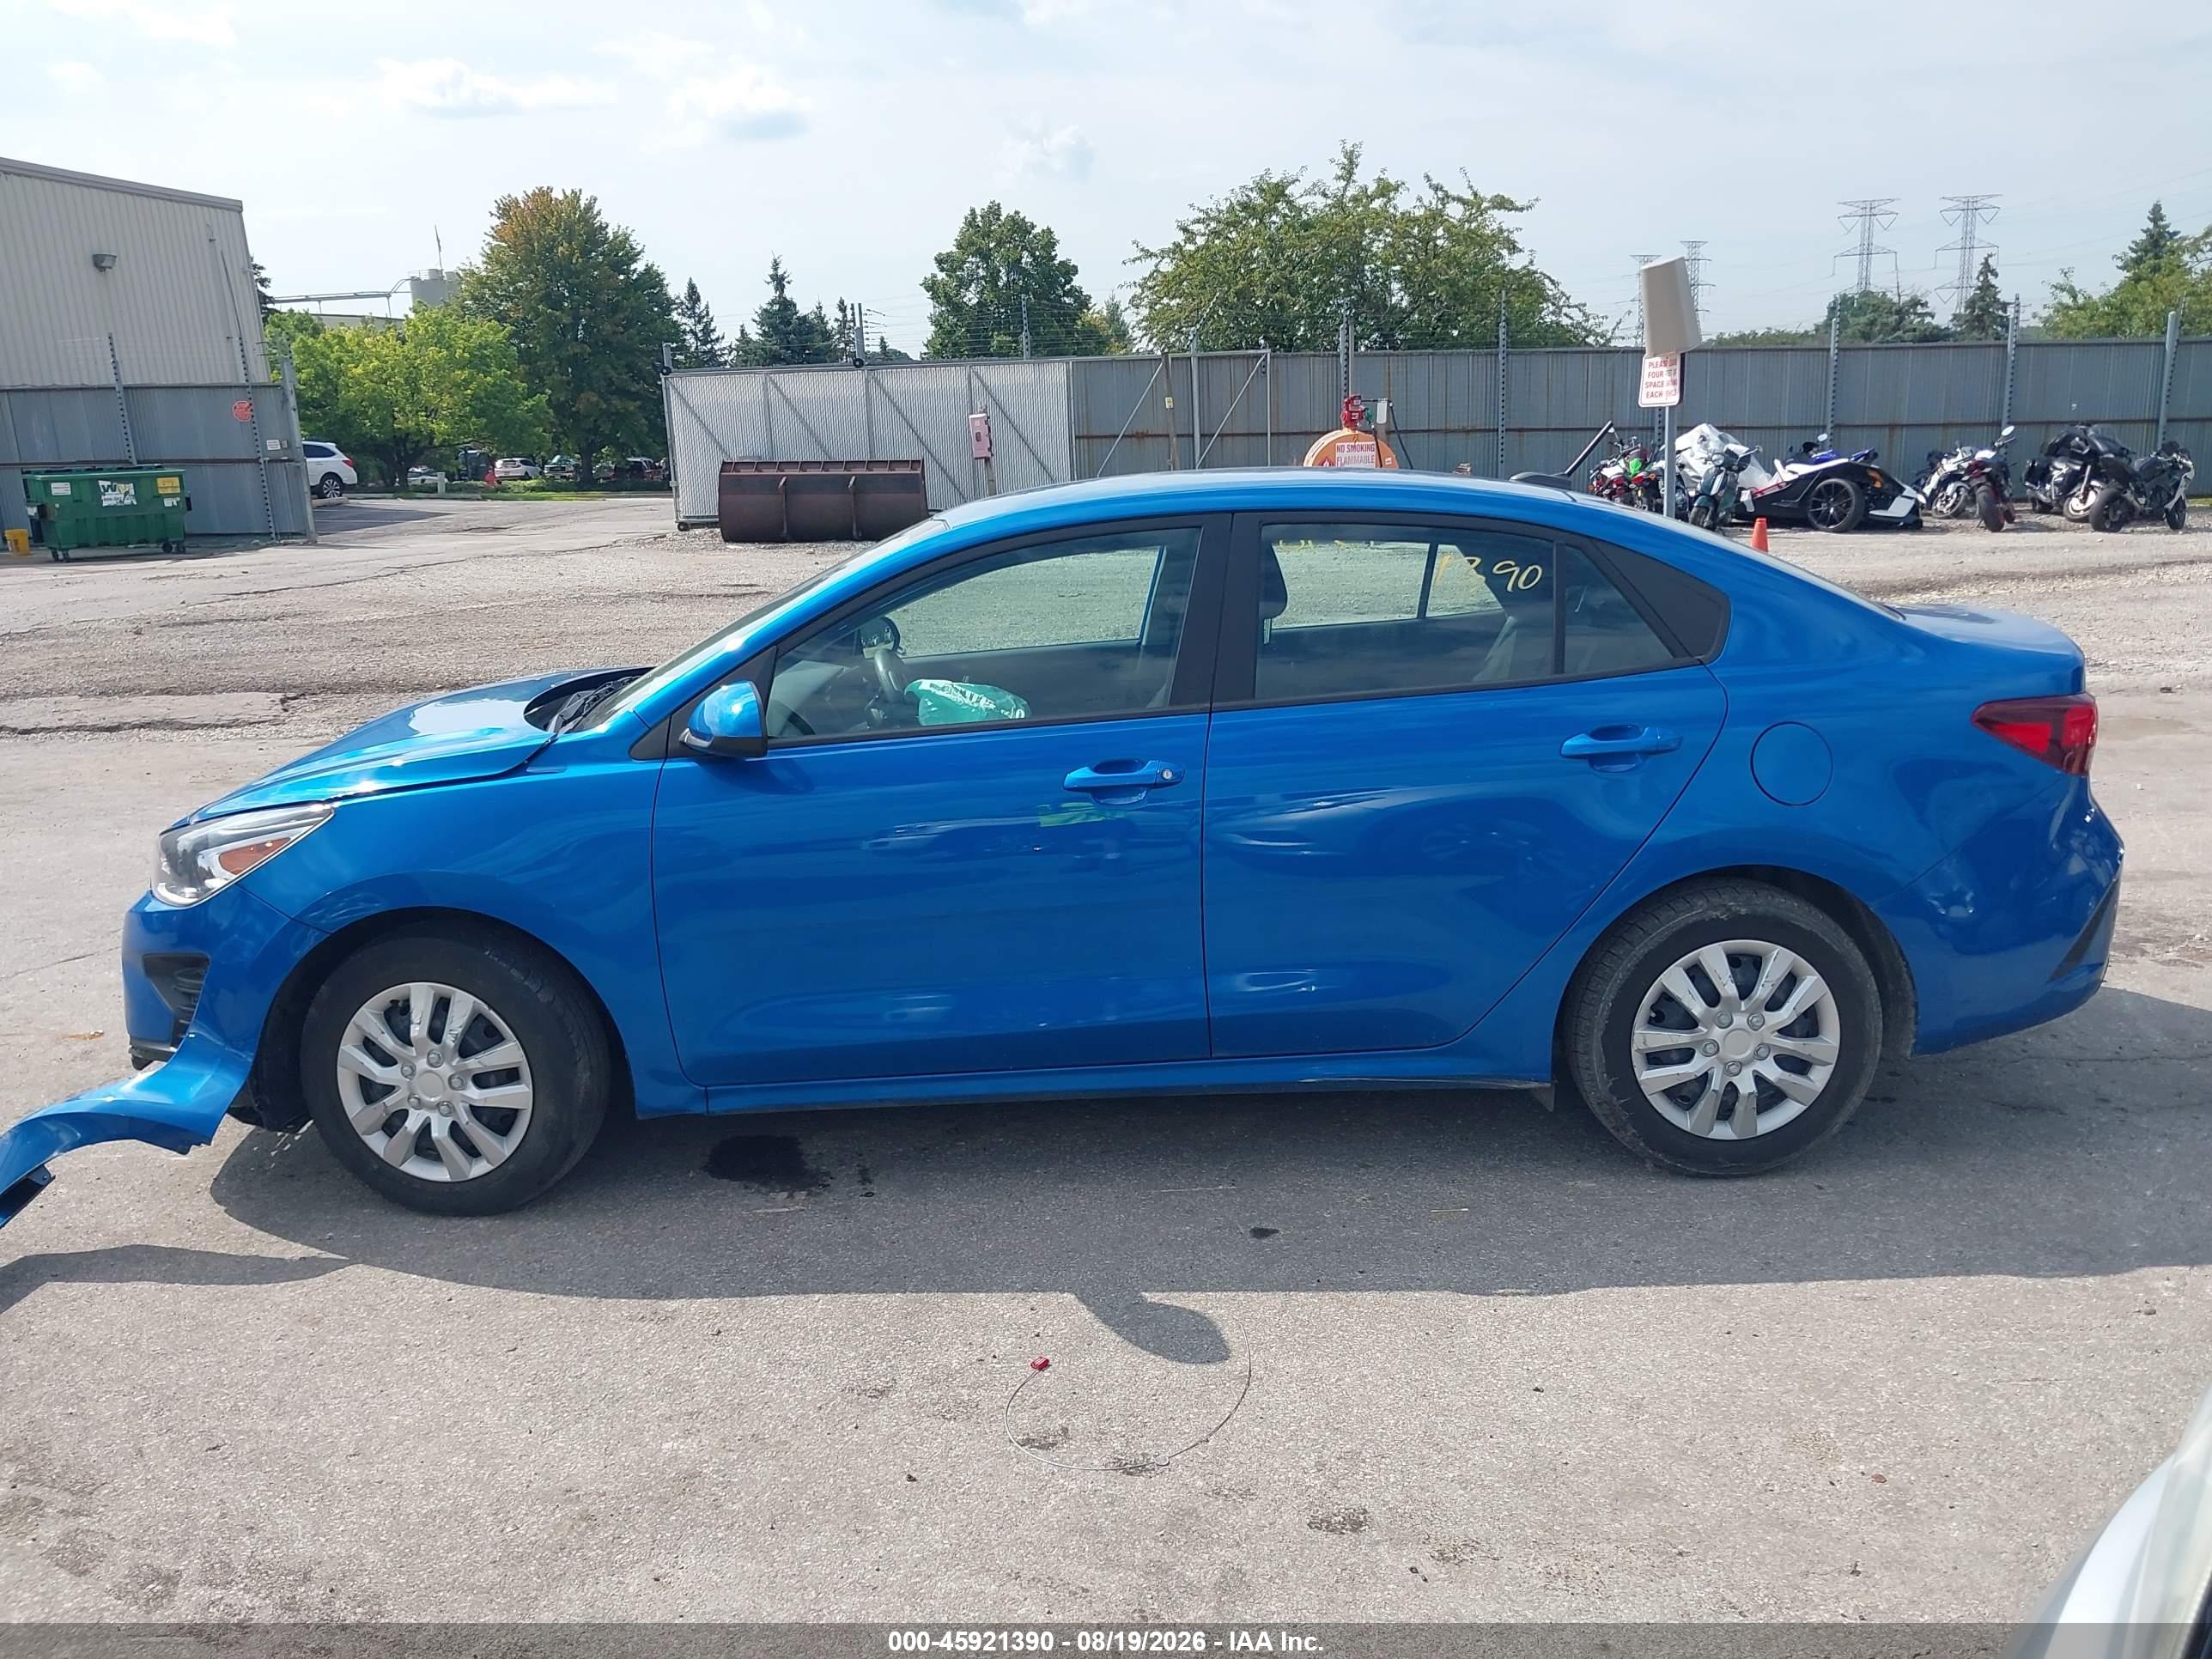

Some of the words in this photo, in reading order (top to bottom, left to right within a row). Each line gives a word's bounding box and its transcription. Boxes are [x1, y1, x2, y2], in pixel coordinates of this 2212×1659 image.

[1648, 370, 1664, 379] FOUR
[1336, 444, 1346, 453] NO
[1346, 443, 1375, 453] SMOKING
